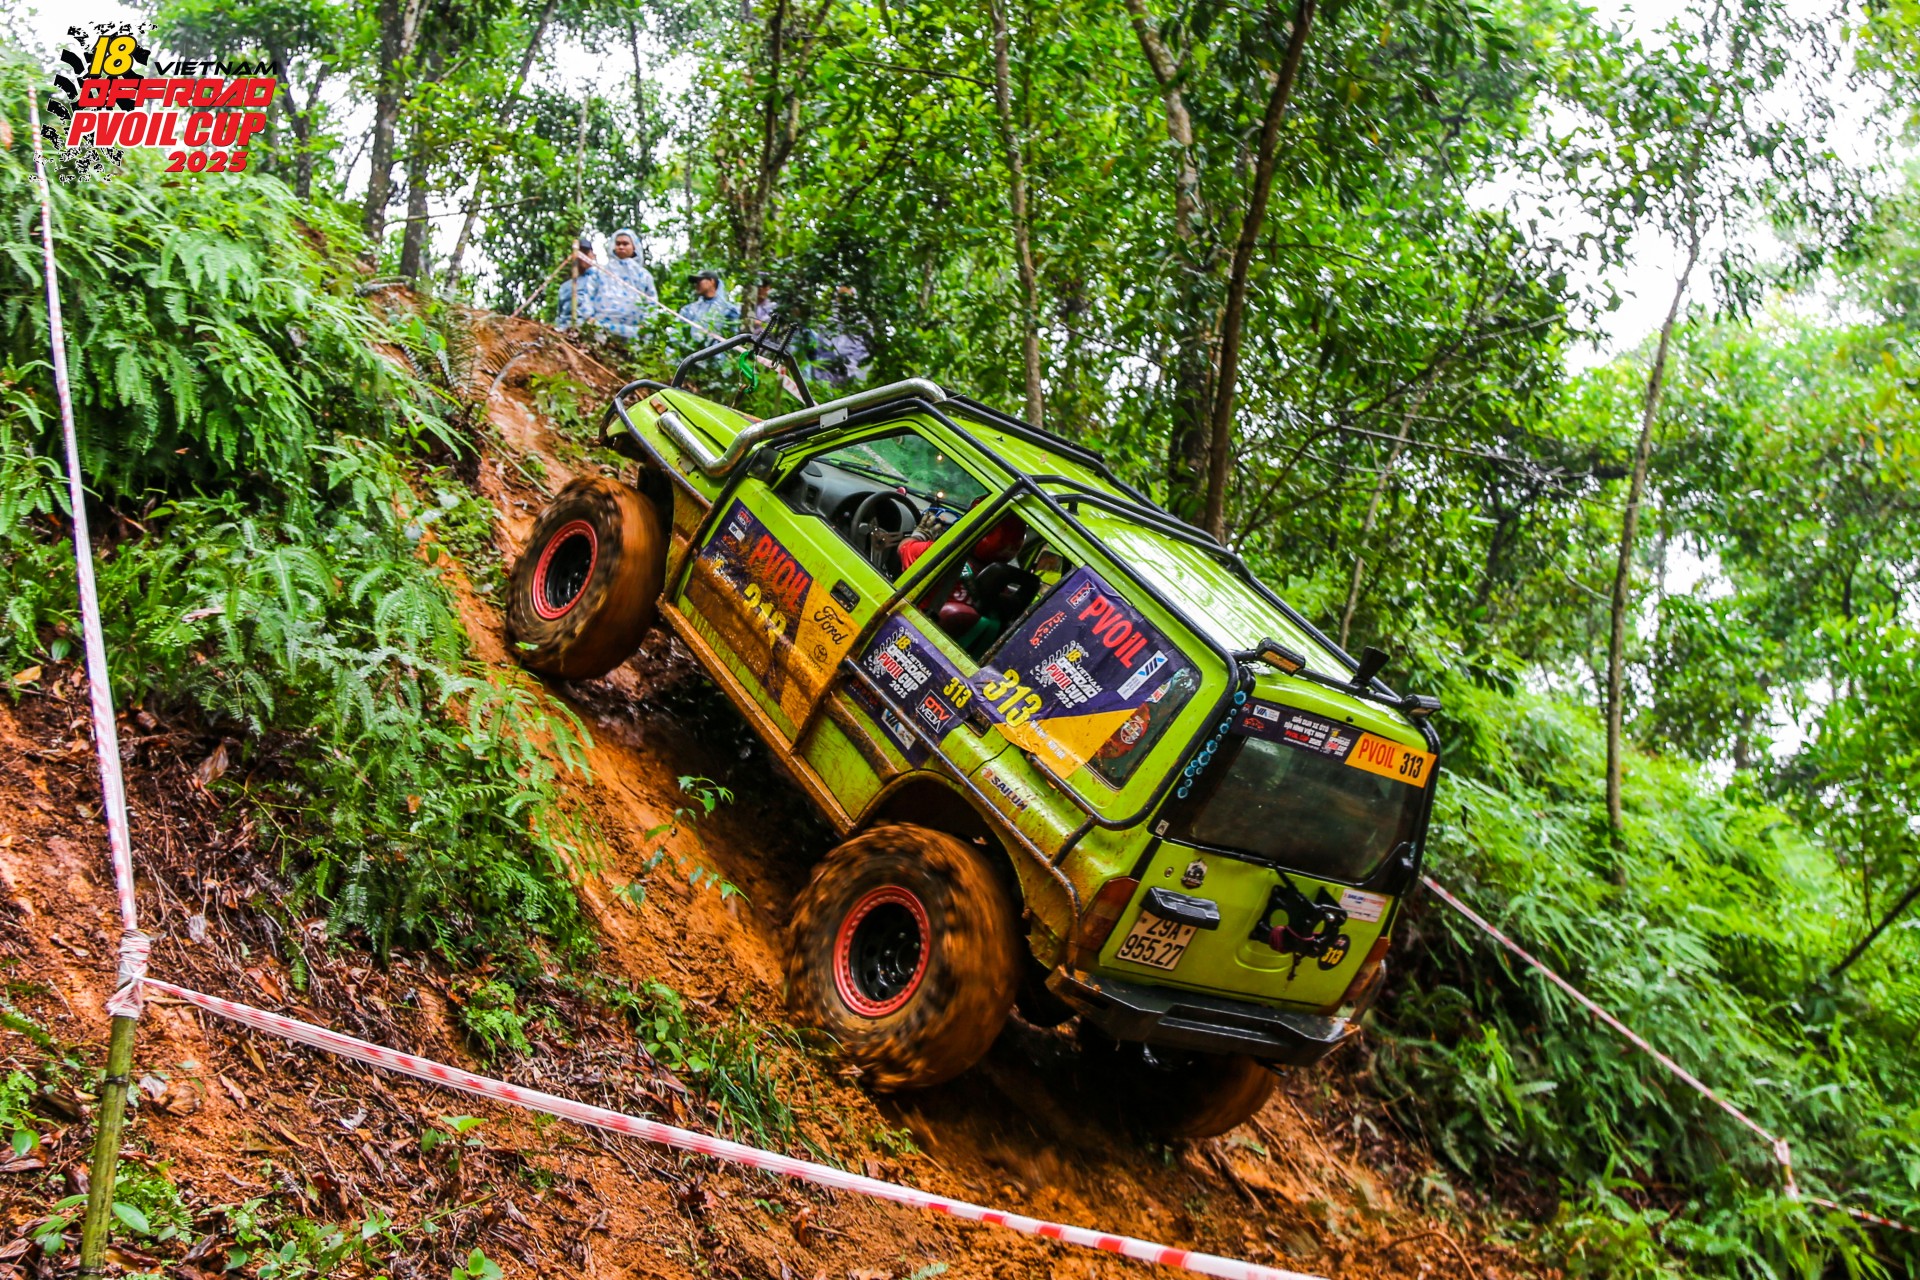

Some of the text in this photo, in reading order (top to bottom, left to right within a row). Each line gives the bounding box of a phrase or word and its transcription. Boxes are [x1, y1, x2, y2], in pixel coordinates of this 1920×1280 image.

[749, 533, 811, 612] PVOIL
[813, 605, 849, 645] Ford
[895, 635, 911, 651] 18
[1078, 595, 1148, 669] PVOIL
[877, 651, 919, 693] PVOIL CUP
[886, 643, 929, 685] OFFROAD
[907, 651, 932, 677] VIETNAM
[1066, 649, 1082, 662] 18
[888, 680, 909, 699] 2025
[943, 677, 973, 708] 313
[1045, 663, 1073, 690] PVOIL
[1065, 683, 1088, 704] CUP
[1056, 656, 1099, 699] OFFROAD
[1076, 664, 1103, 693] VIETNAM
[983, 668, 1043, 728] 313
[1358, 738, 1424, 779] PVOIL 313
[991, 775, 1028, 812] SAILUN
[1120, 934, 1185, 967] 955.27
[1321, 946, 1344, 965] 313
